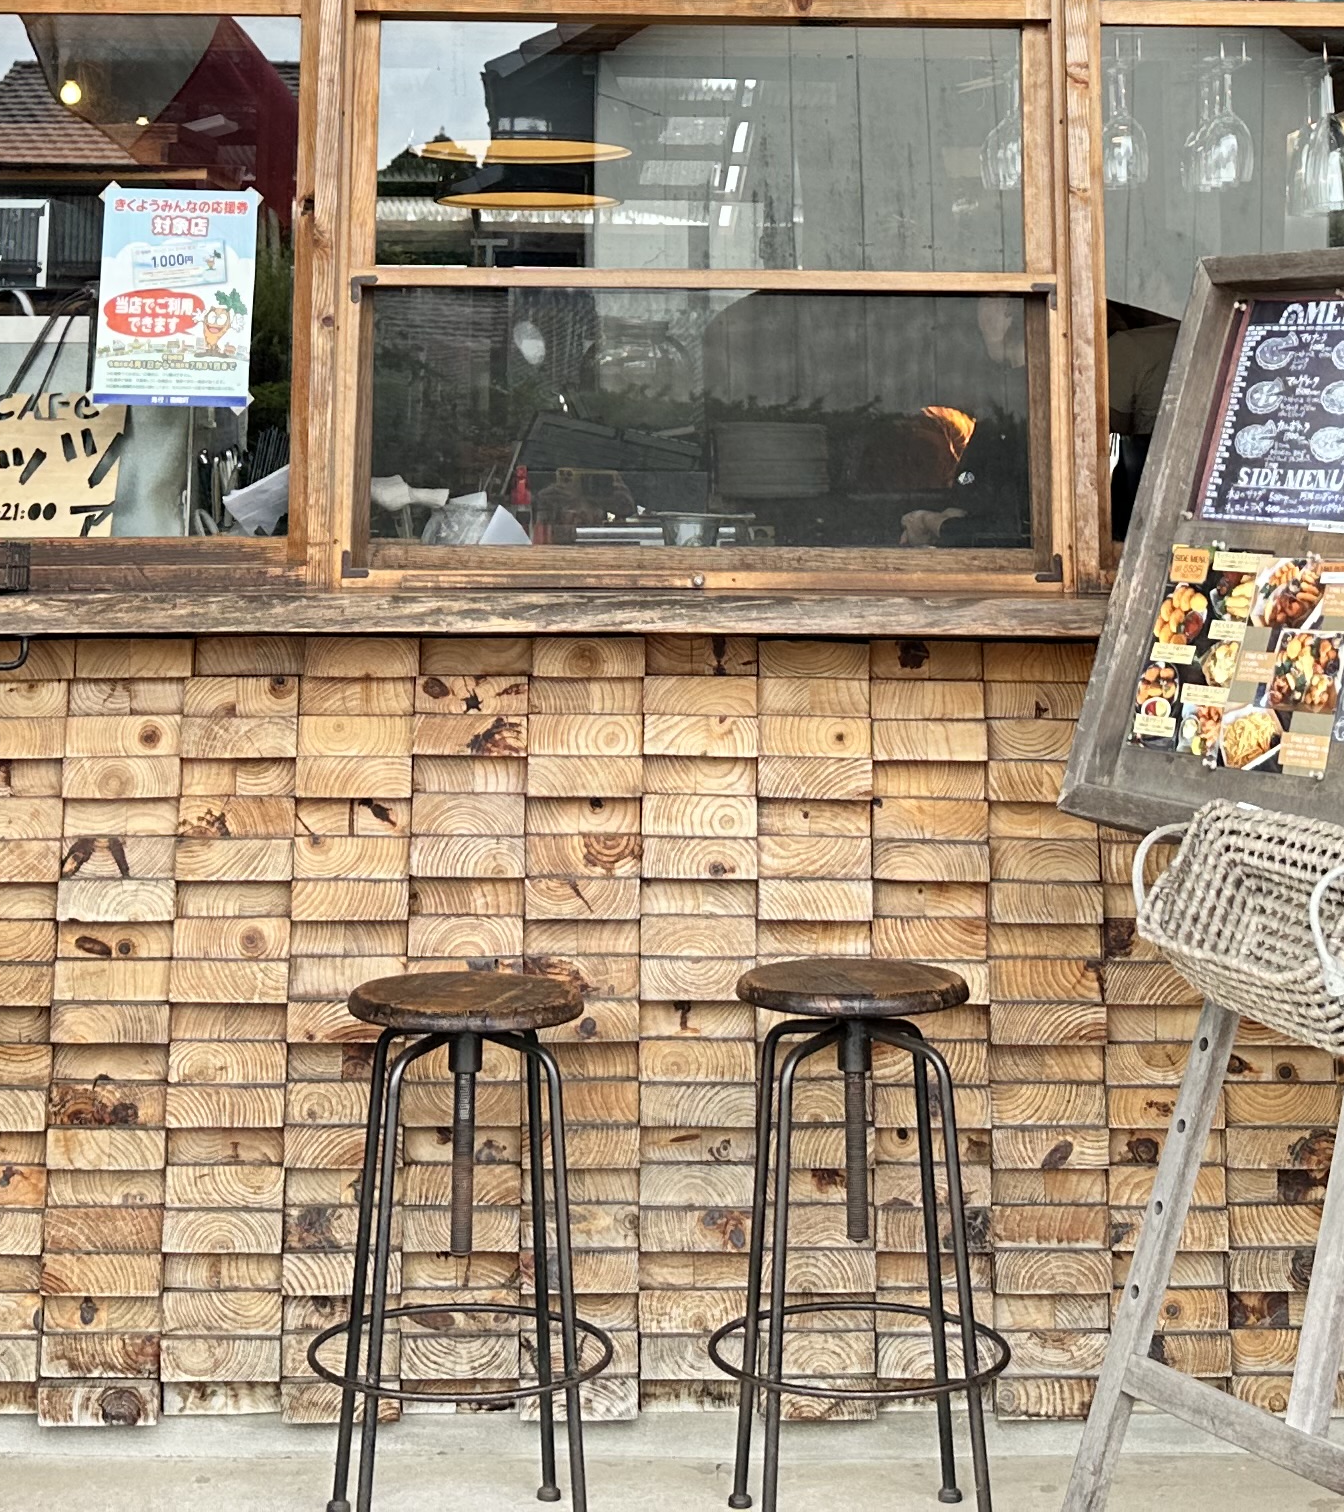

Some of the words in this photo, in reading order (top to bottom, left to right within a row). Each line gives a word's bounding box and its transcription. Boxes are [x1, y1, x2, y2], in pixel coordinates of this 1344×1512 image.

[152, 215, 209, 237] 対象店
[115, 296, 194, 316] 当店でご利用
[128, 316, 180, 333] できます
[1237, 467, 1284, 487] SIDE
